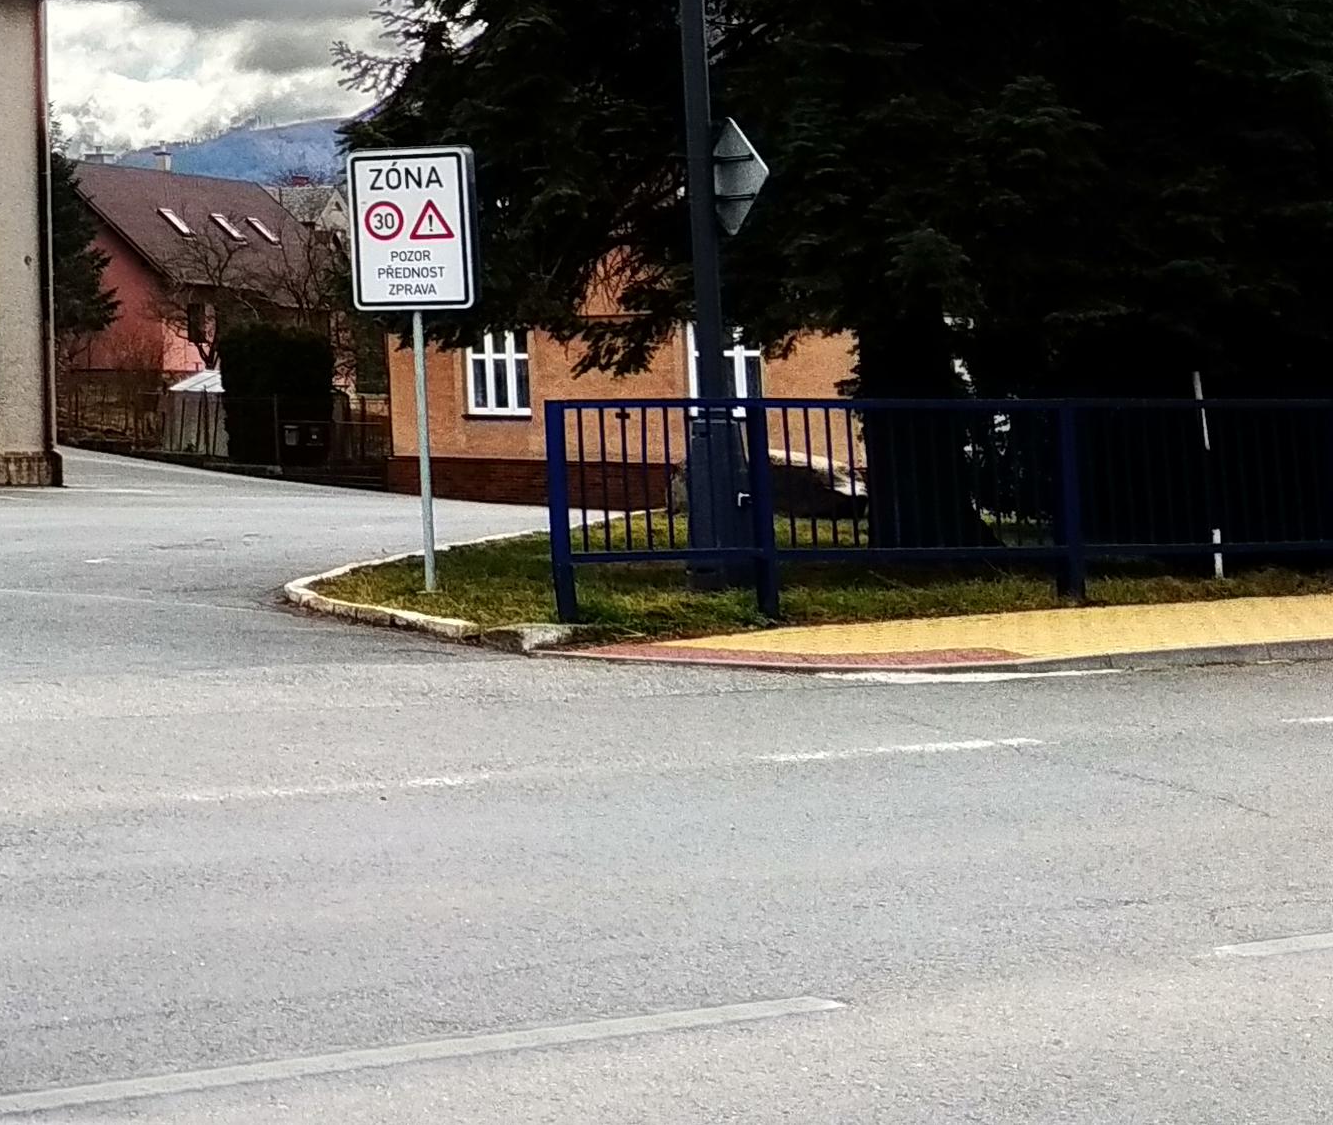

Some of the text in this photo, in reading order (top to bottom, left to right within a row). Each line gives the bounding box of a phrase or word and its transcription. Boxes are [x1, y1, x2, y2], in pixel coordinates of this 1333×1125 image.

[369, 161, 444, 191] ZÓNA
[373, 212, 395, 230] 30
[390, 250, 432, 262] POZOR
[377, 265, 446, 280] PŘEDNOST
[388, 283, 438, 296] ZPRAVA
